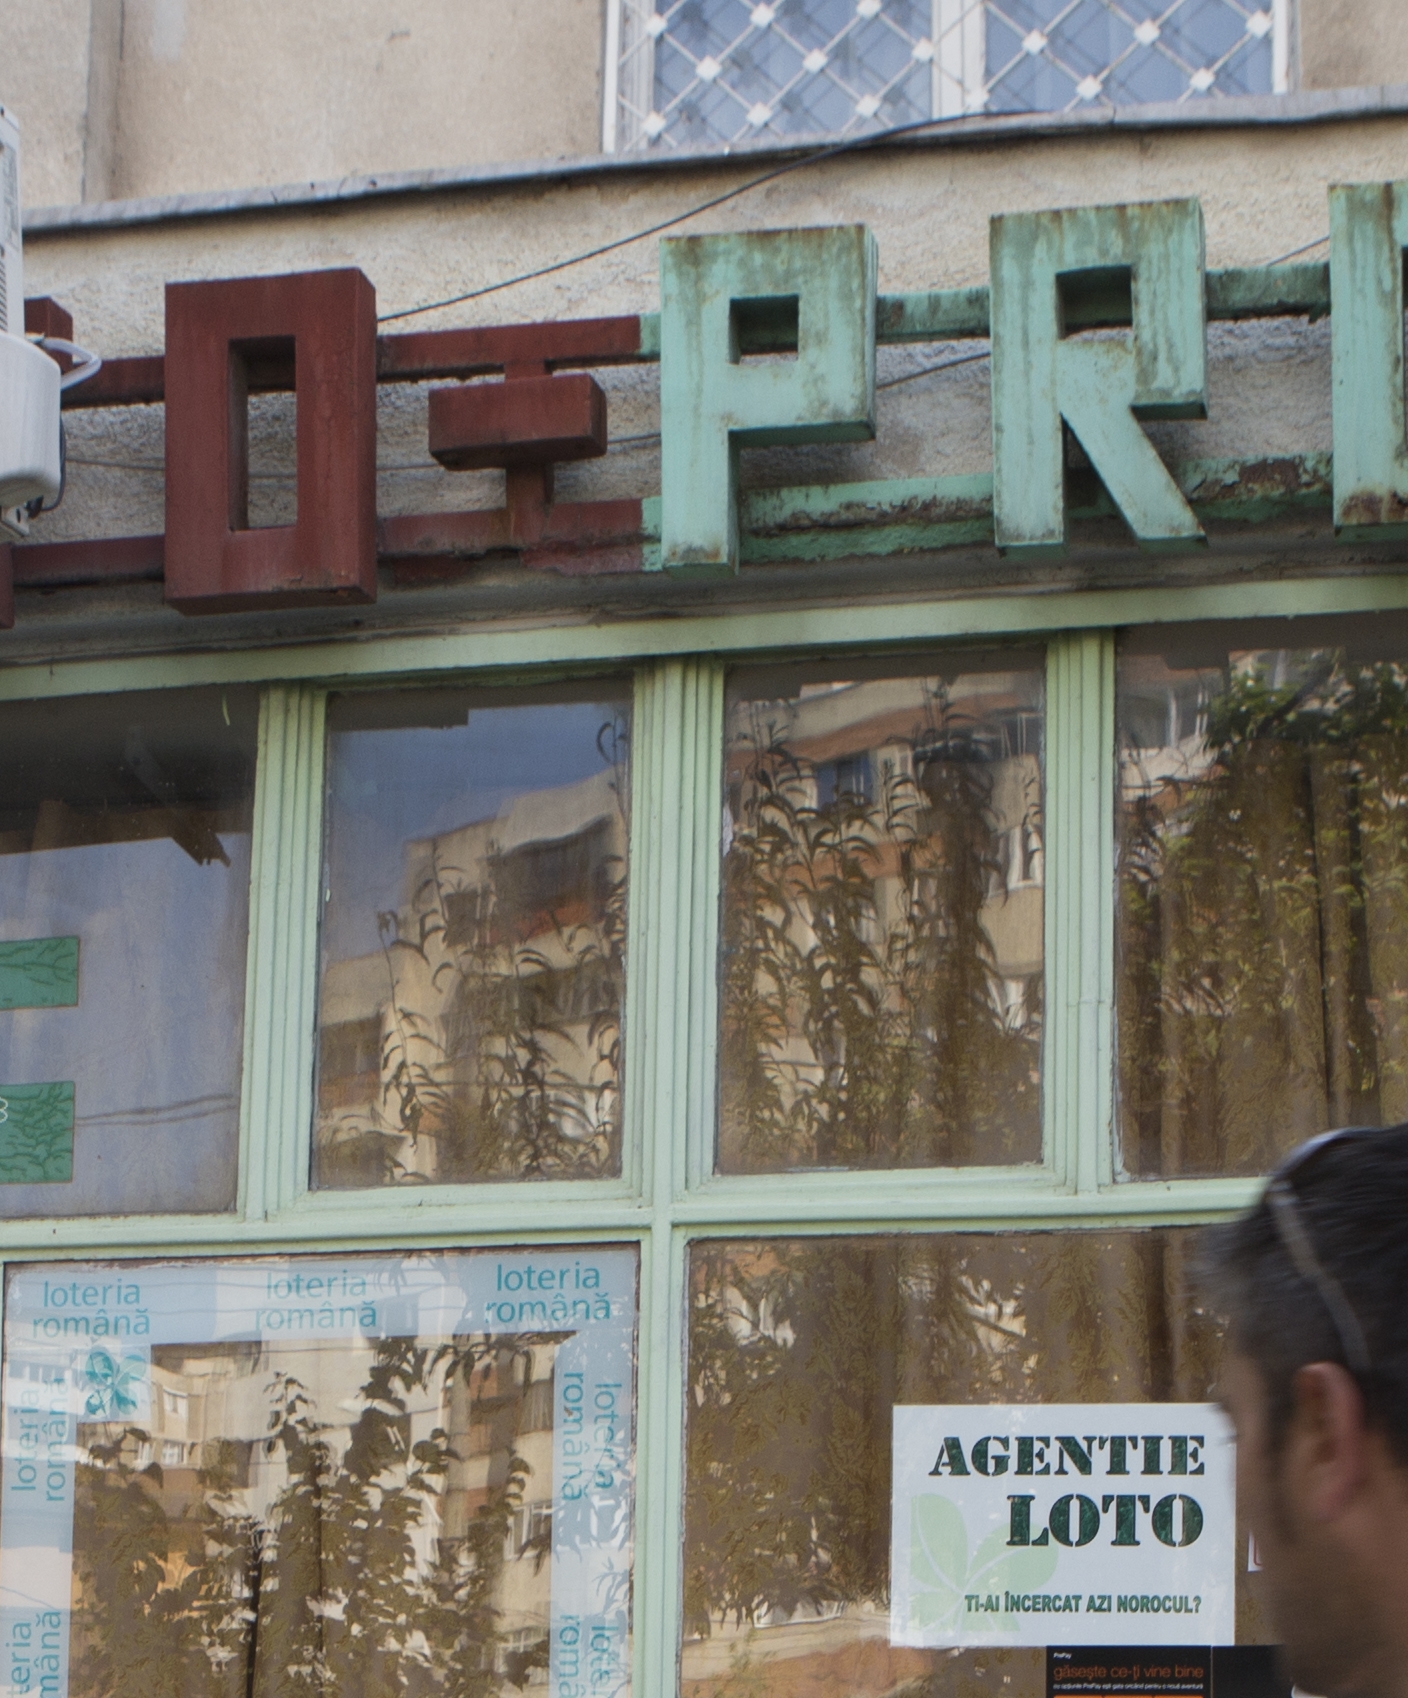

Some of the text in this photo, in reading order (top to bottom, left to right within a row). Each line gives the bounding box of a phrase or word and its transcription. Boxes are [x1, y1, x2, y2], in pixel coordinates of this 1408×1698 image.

[267, 1269, 367, 1298] loteria
[496, 1261, 601, 1291] loteria
[43, 1278, 141, 1307] loteria
[485, 1292, 611, 1324] română
[32, 1307, 151, 1339] română
[255, 1299, 377, 1331] română
[11, 1389, 39, 1492] loteria
[46, 1376, 69, 1502] română
[562, 1371, 590, 1502] română
[593, 1383, 623, 1492] loteria
[928, 1435, 1206, 1477] AGENTIE
[1006, 1494, 1204, 1548] LOTO
[964, 1591, 1202, 1614] TI-AI ÎNCERCAT AZI NOROCUL?
[1144, 1665, 1171, 1678] vine
[1175, 1665, 1204, 1678] bine
